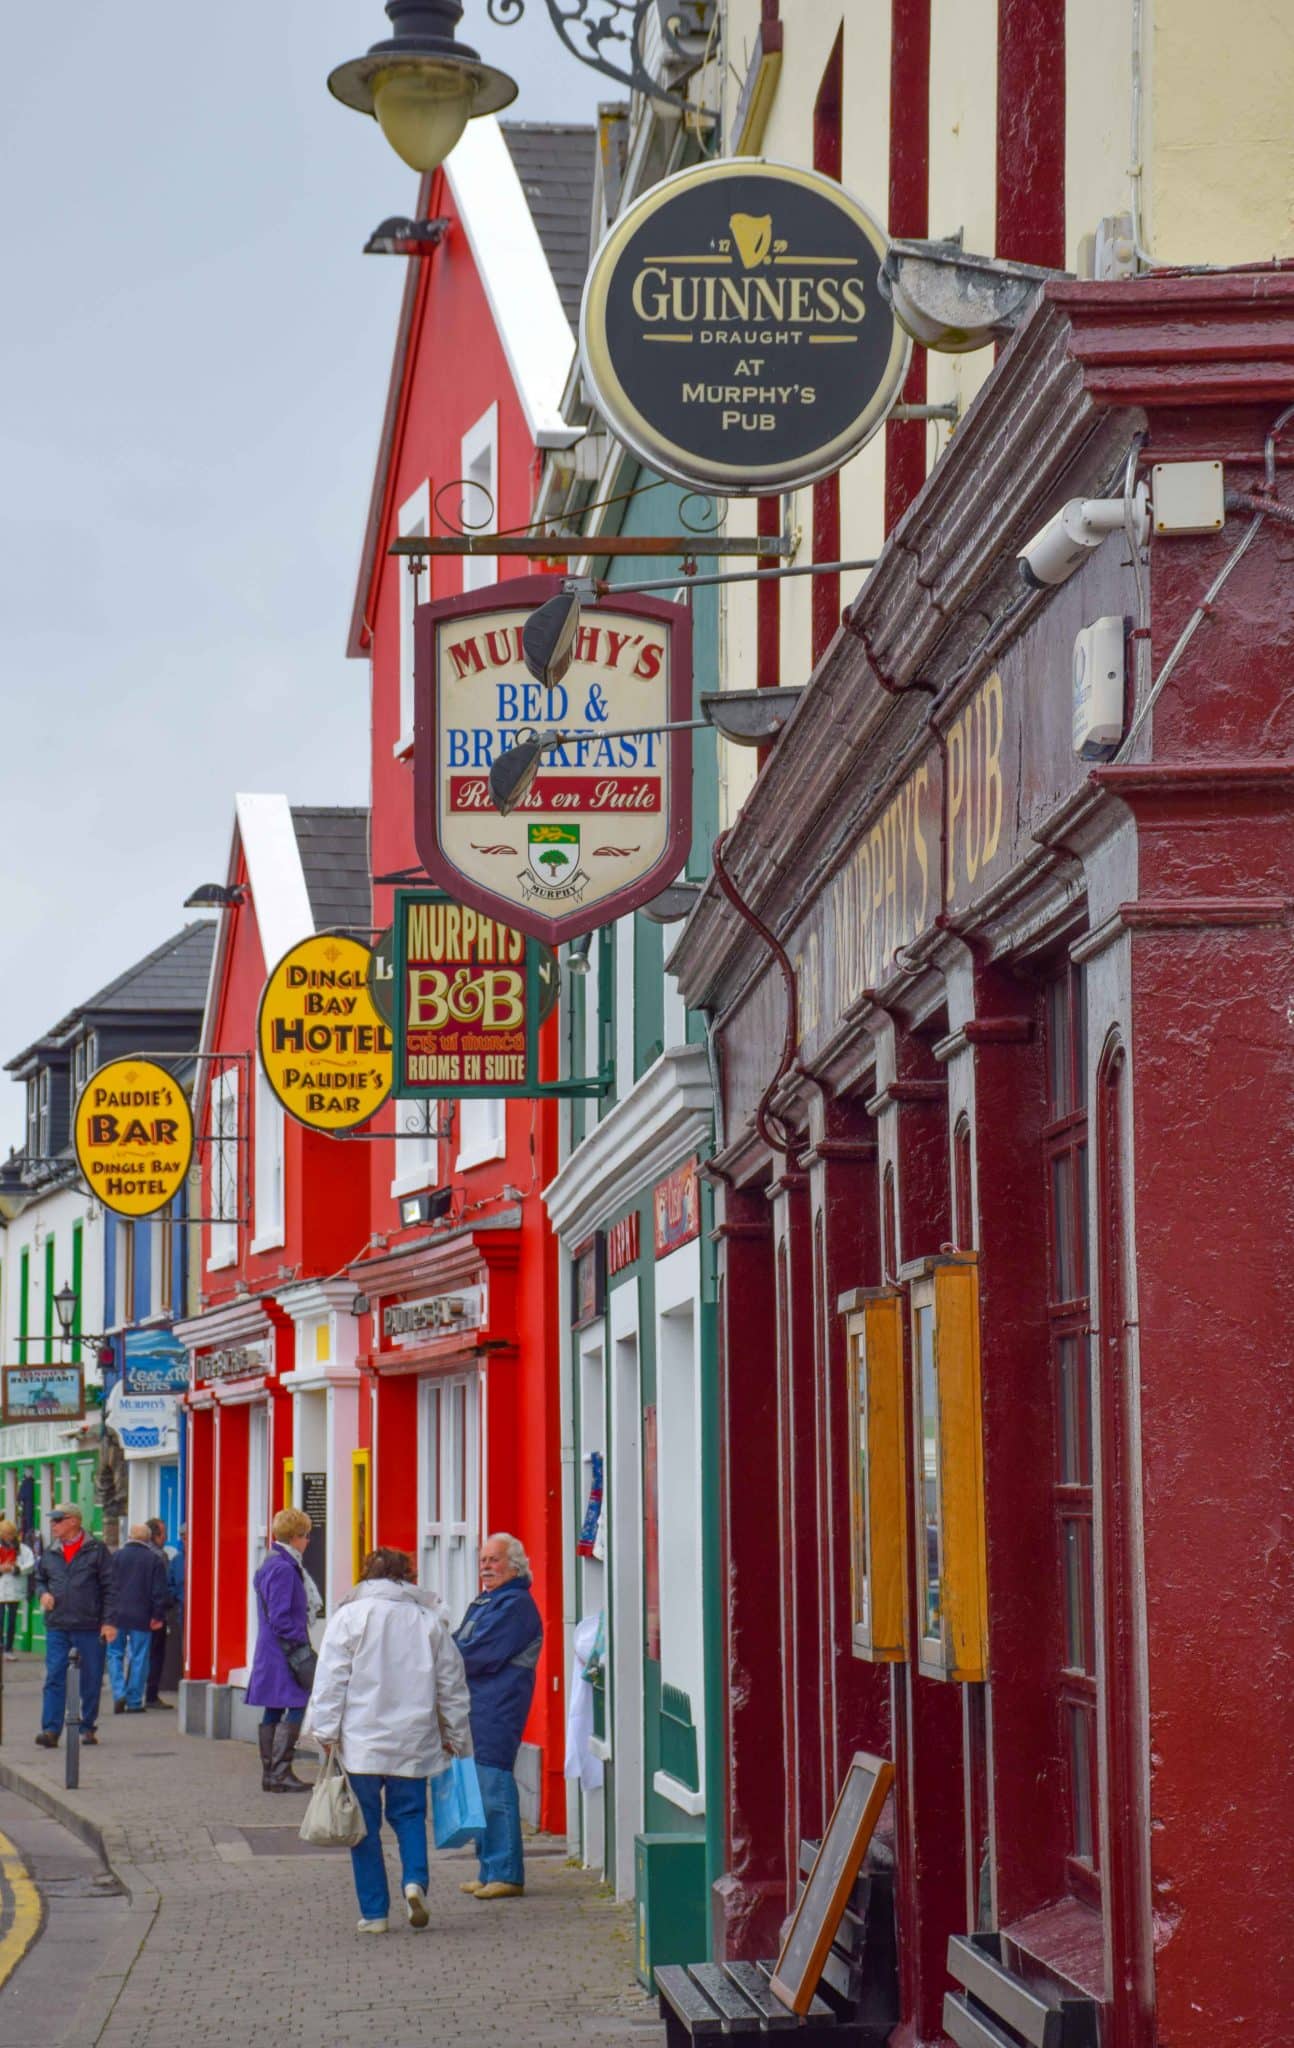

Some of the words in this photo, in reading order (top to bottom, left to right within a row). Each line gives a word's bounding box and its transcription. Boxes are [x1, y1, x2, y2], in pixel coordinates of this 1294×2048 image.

[632, 267, 866, 323] GUINNESS
[700, 331, 803, 344] DRAUGHT
[734, 360, 764, 376] AT
[682, 383, 816, 404] MURPHY'S
[722, 410, 776, 430] PUB
[448, 626, 664, 680] MUHY'S
[496, 683, 568, 722] BED
[584, 683, 608, 722] &
[447, 728, 661, 768] BREKFAST
[551, 791, 581, 808] en
[589, 780, 656, 808] Suite
[947, 670, 1004, 901] PUB
[531, 885, 576, 898] MURPHY
[288, 965, 367, 988] DINGL
[306, 992, 357, 1014] BAY
[408, 967, 523, 1029] B&B
[273, 1018, 392, 1052] HOTEL
[284, 1068, 383, 1089] PAUDIE'S
[408, 1055, 459, 1080] ROOMS
[464, 1055, 480, 1080] EN
[485, 1055, 525, 1080] SUITE
[94, 1087, 173, 1107] PAUDIE'S
[307, 1093, 360, 1112] BAR
[88, 1114, 178, 1147] BAR
[92, 1161, 145, 1175] DINGLE
[151, 1160, 181, 1173] BAY
[106, 1178, 167, 1195] HOTEL
[10, 1376, 75, 1384] RESTAURANT
